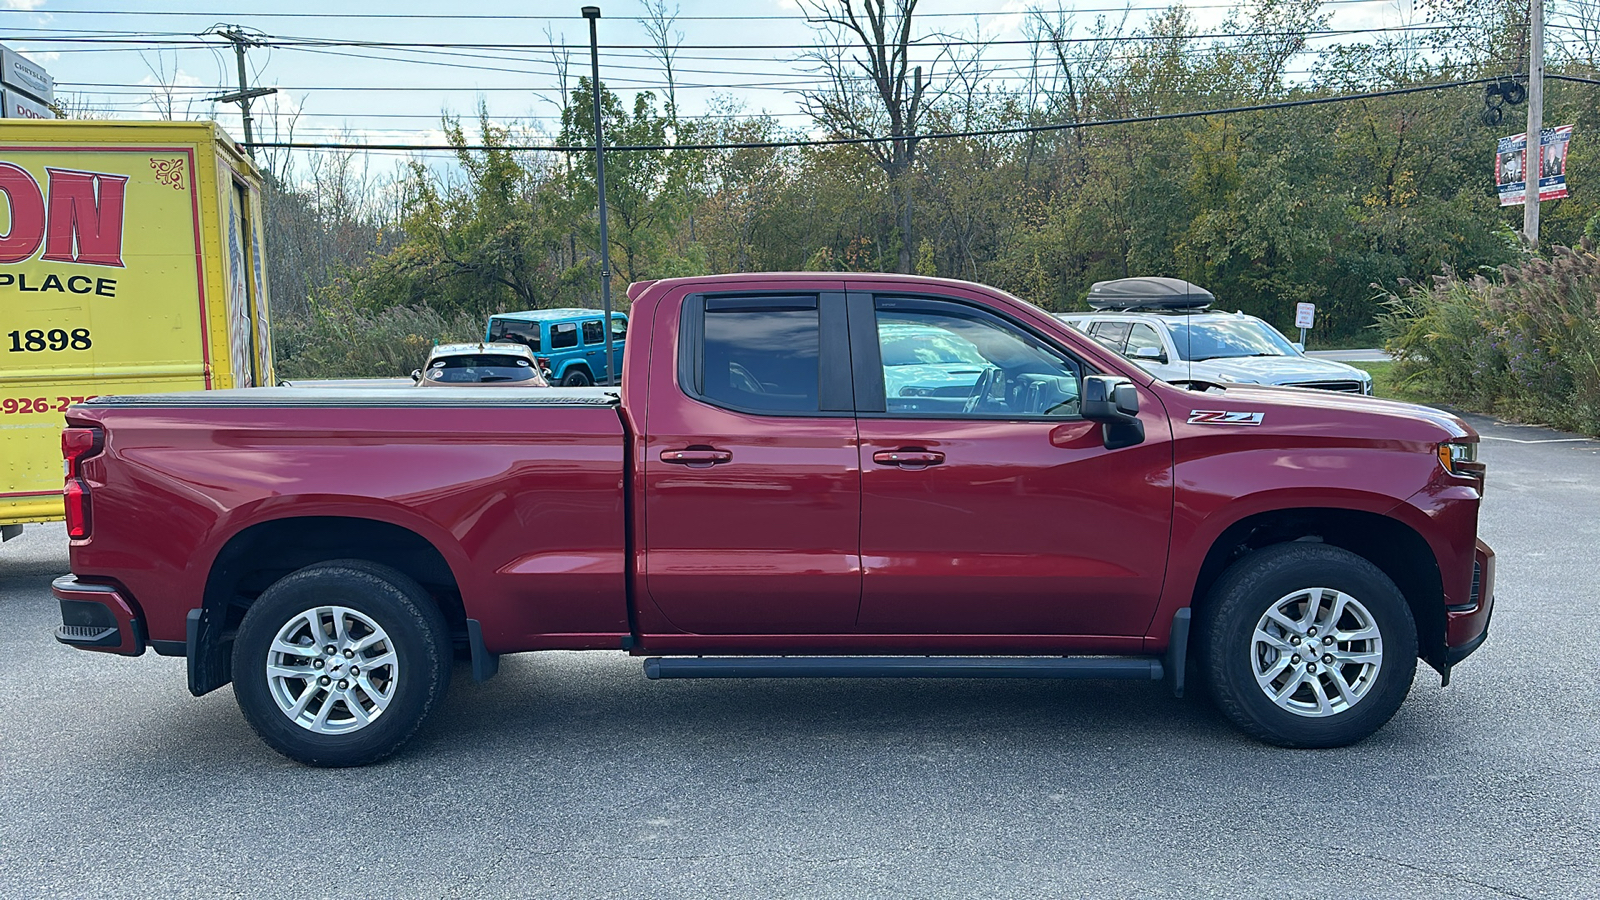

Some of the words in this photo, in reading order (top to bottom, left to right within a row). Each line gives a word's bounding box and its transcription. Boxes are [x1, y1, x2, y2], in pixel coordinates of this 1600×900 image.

[14, 62, 48, 84] CHRYSLER
[17, 104, 49, 118] DOD
[0, 273, 117, 297] PLACE
[8, 328, 92, 352] 1898
[1186, 409, 1265, 426] Z71
